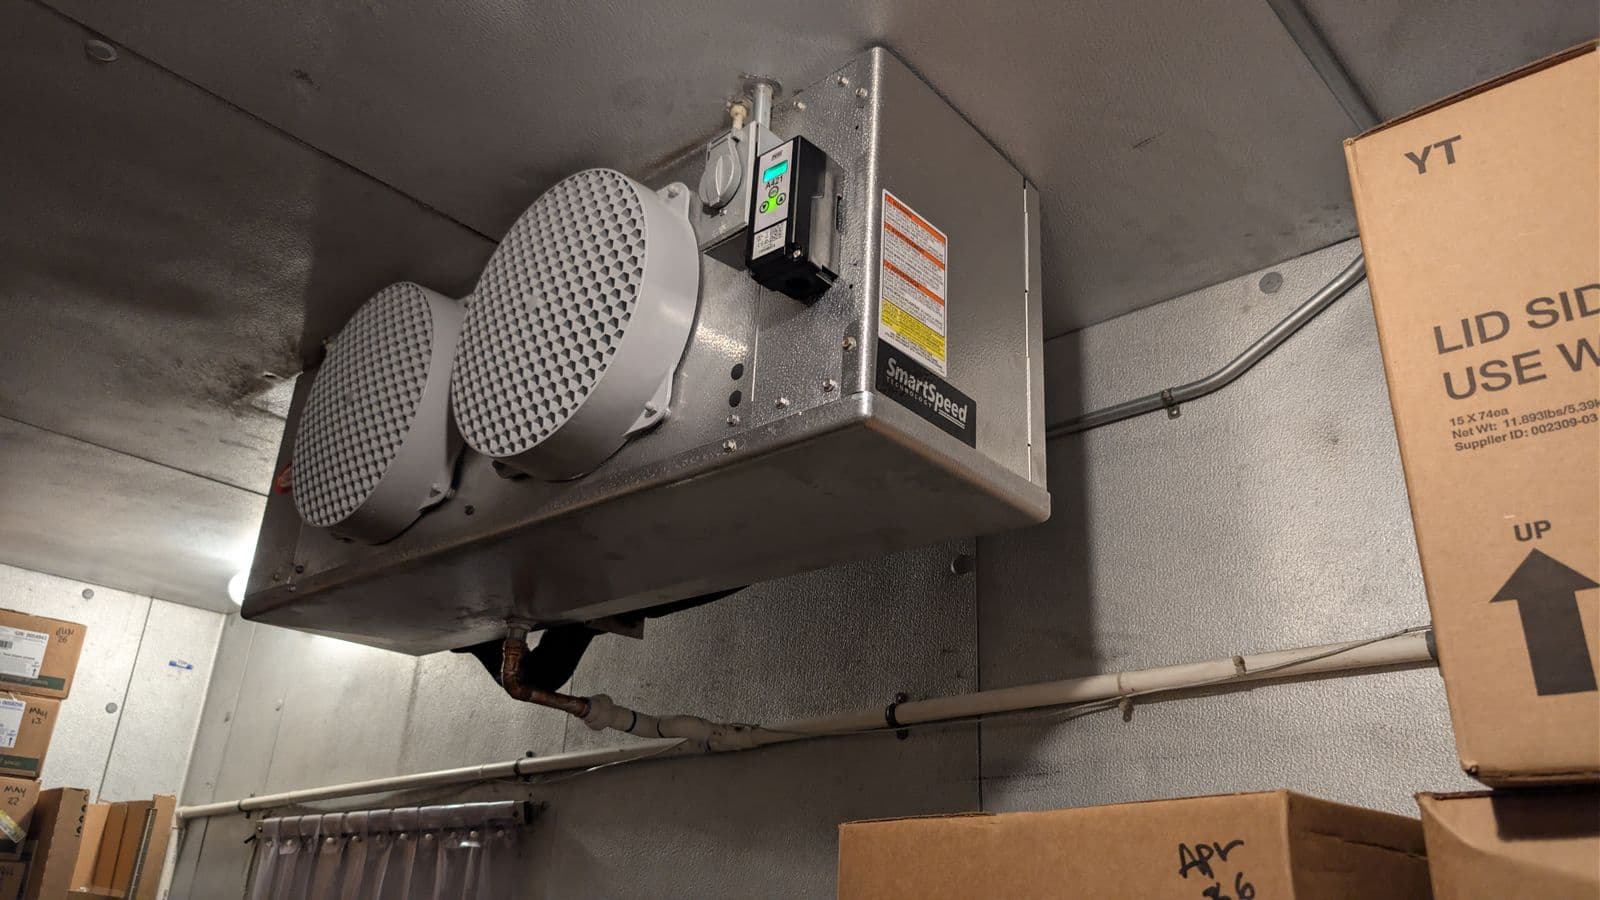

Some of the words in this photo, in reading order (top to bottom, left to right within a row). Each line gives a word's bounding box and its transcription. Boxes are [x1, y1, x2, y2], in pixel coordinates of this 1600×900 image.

[1404, 134, 1462, 175] YT
[1433, 310, 1510, 355] LID
[887, 357, 968, 424] SmartSpeed
[1443, 348, 1547, 400] USE
[1450, 416, 1465, 426] 15
[1478, 407, 1510, 420] 74ea
[1452, 428, 1474, 439] Net
[1475, 422, 1497, 434] Wt:
[1454, 433, 1507, 452] Supplier
[1510, 429, 1529, 440] ID:
[1531, 413, 1599, 436] 002309-03
[1513, 520, 1551, 541] UP
[4, 785, 27, 797] MAY
